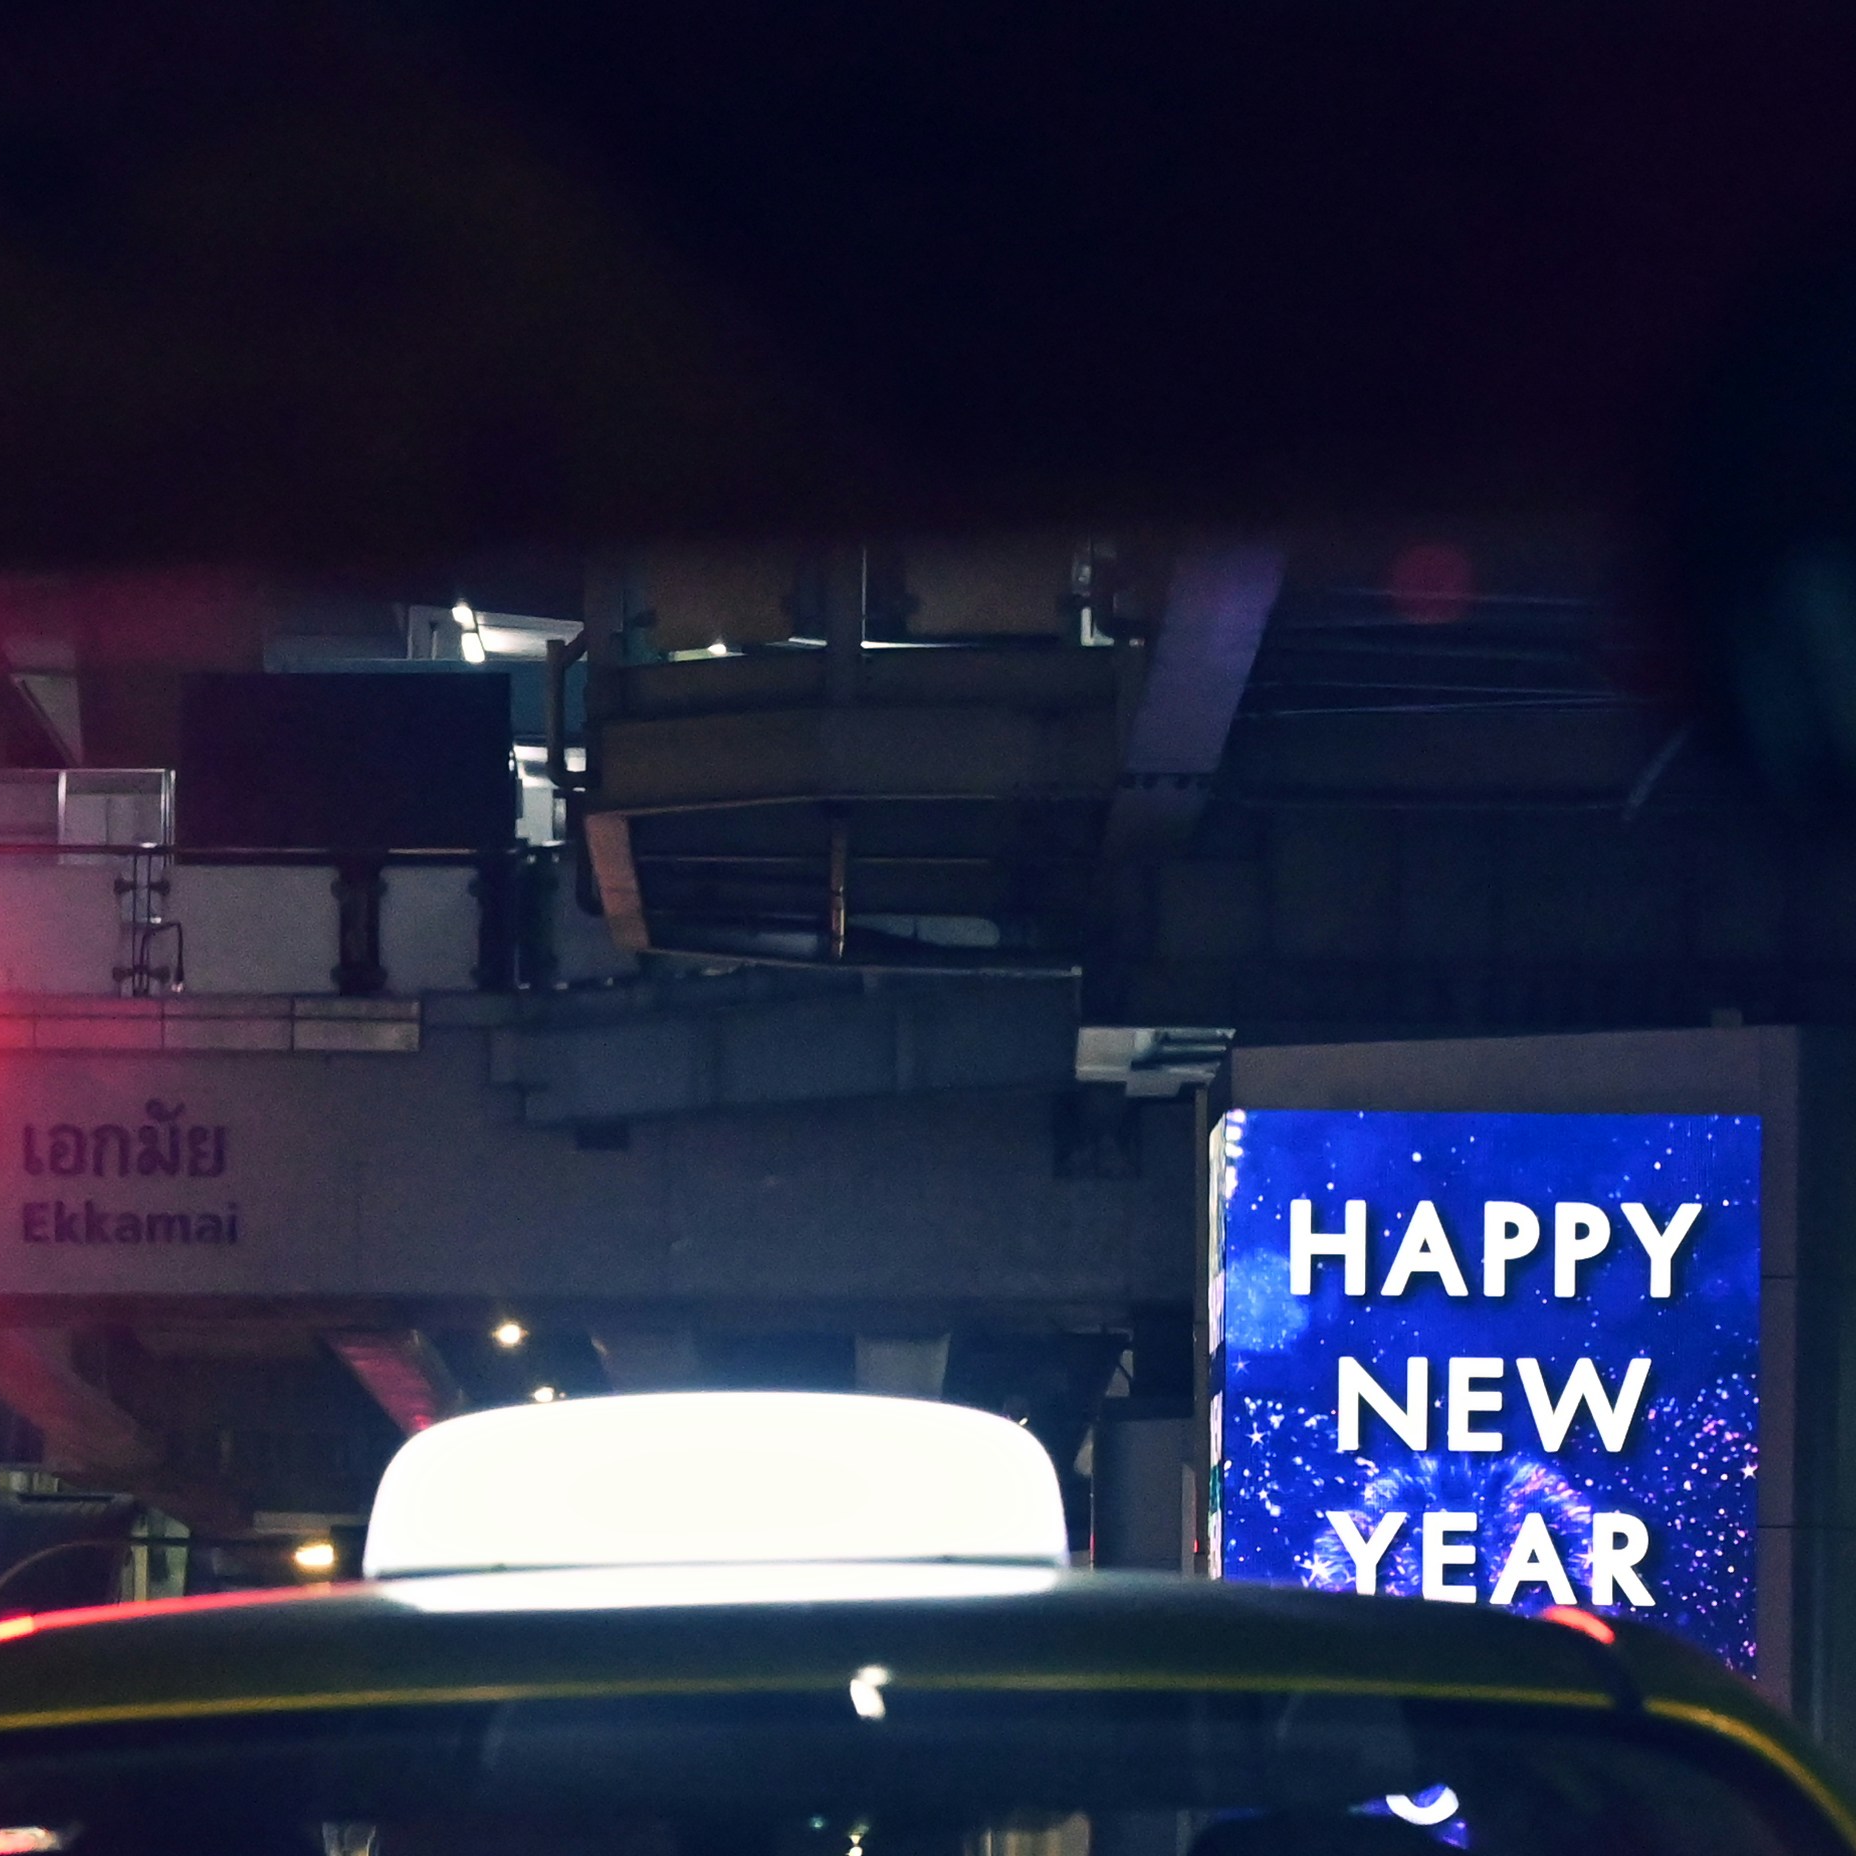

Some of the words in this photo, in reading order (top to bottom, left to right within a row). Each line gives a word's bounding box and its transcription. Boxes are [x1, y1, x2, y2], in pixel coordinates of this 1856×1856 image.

[23, 1098, 227, 1177] เอกมัย
[22, 1200, 238, 1244] Ekkamai
[1289, 1199, 1703, 1299] HAPPY
[1338, 1356, 1652, 1453] NEW
[1327, 1511, 1656, 1607] YEAR
